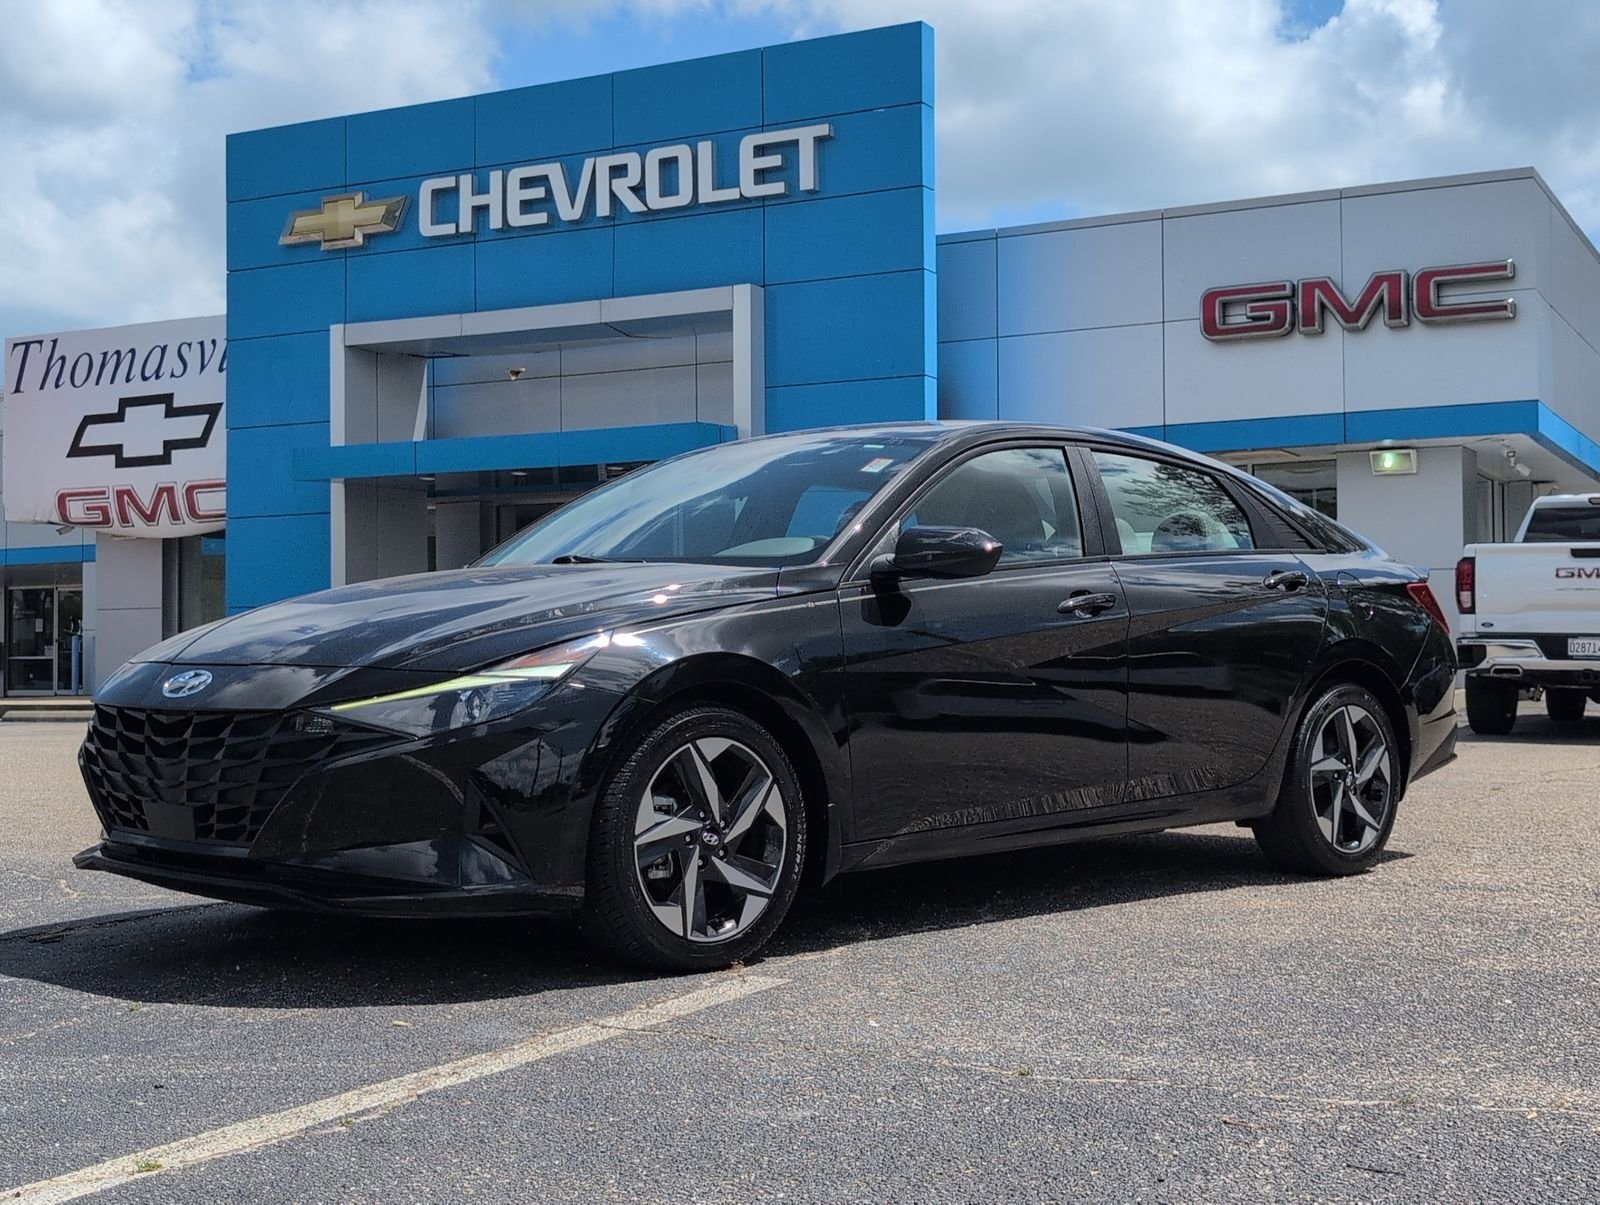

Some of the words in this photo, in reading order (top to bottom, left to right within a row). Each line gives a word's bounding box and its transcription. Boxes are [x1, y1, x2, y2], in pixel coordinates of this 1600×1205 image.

[419, 124, 834, 238] CHEVROLET
[1200, 258, 1515, 342] GMC
[55, 478, 227, 528] GMC
